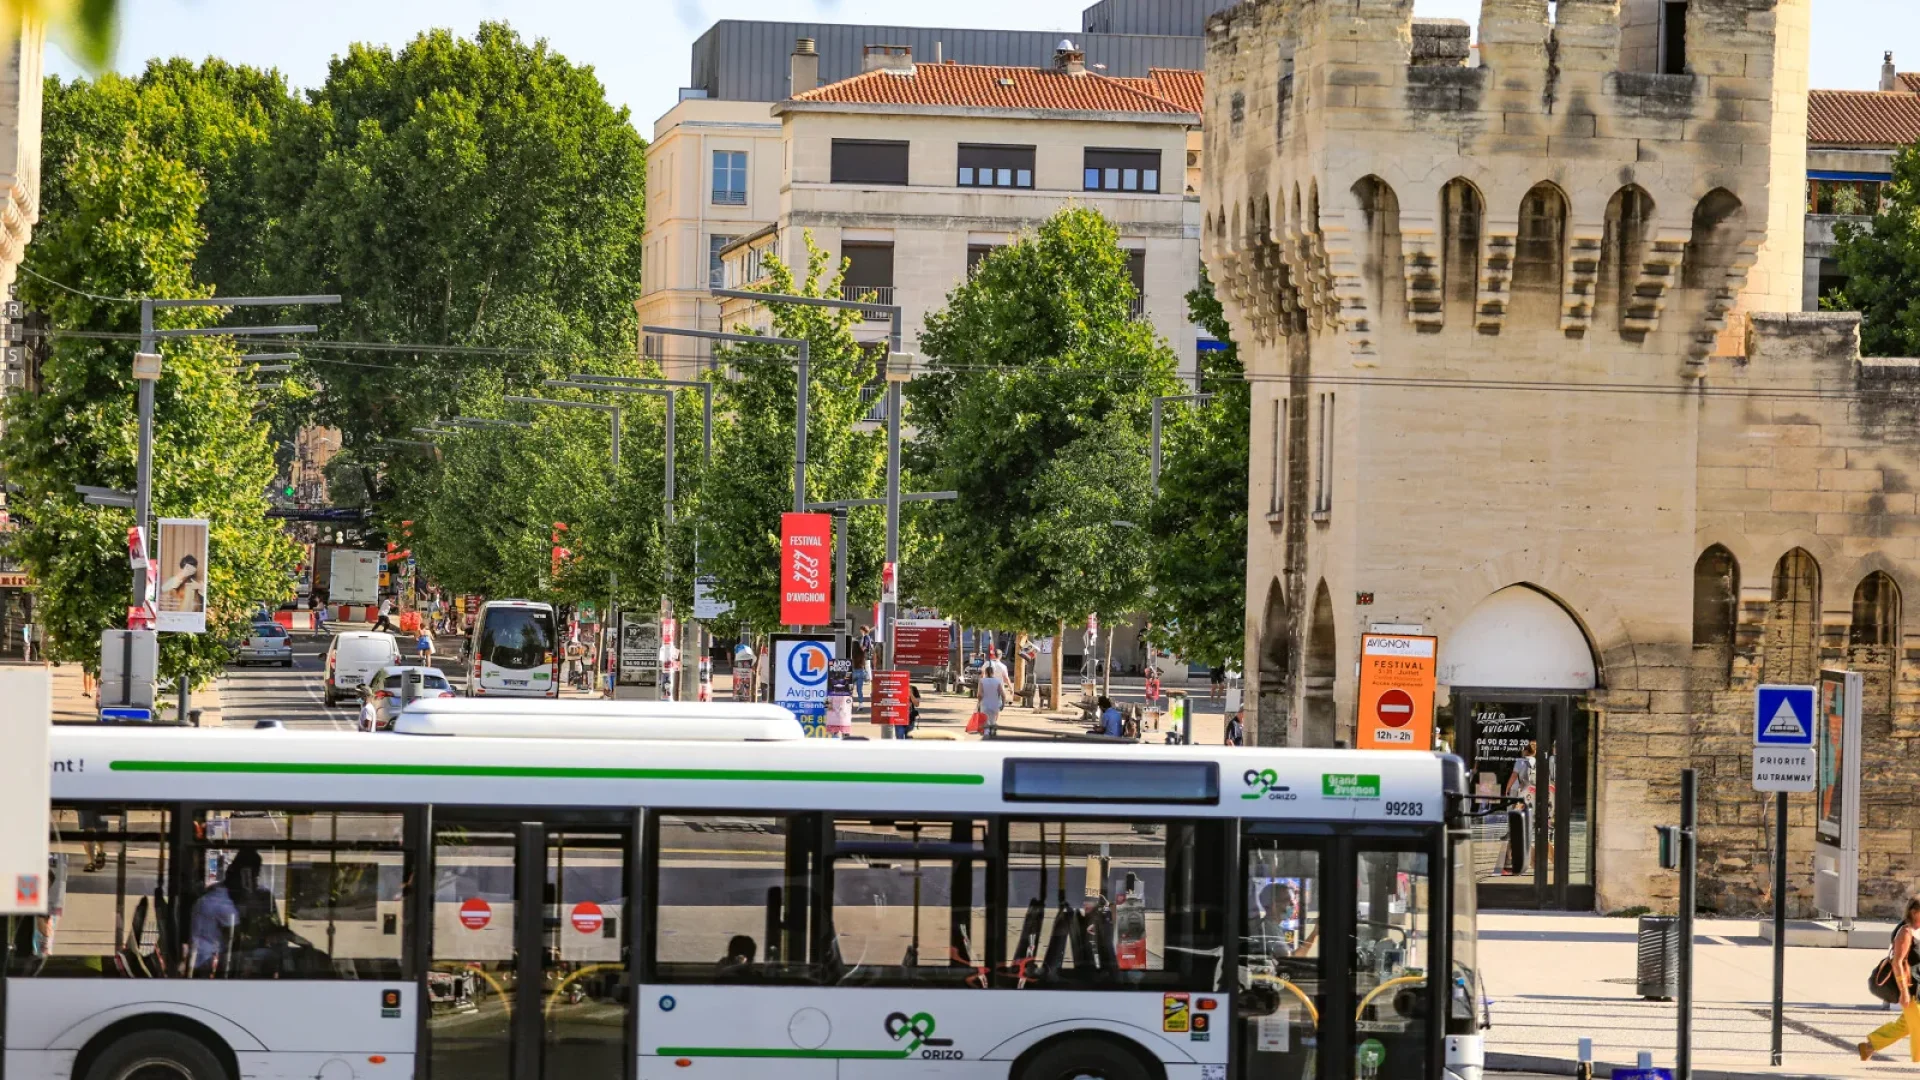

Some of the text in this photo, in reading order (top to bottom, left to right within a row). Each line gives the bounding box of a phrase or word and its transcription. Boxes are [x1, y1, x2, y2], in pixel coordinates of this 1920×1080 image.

[790, 535, 823, 546] FESTIVAL
[786, 592, 826, 603] D'AVIGNON
[1367, 638, 1410, 649] AVIGNON
[1374, 660, 1424, 671] FESTIVAL
[786, 687, 826, 699] Avigno
[799, 701, 826, 709] Eisenh
[1477, 712, 1497, 720] TAXI
[1482, 724, 1522, 734] AVIGNON
[1377, 731, 1392, 740] 12h
[1400, 732, 1411, 740] 2h
[1760, 756, 1806, 766] PRIORITÉ
[1328, 775, 1358, 787] grand
[1757, 773, 1812, 782] AU TRAMWAY
[1333, 786, 1376, 797] avignon
[1385, 801, 1423, 816] 99283
[921, 1049, 964, 1061] ORIZO
